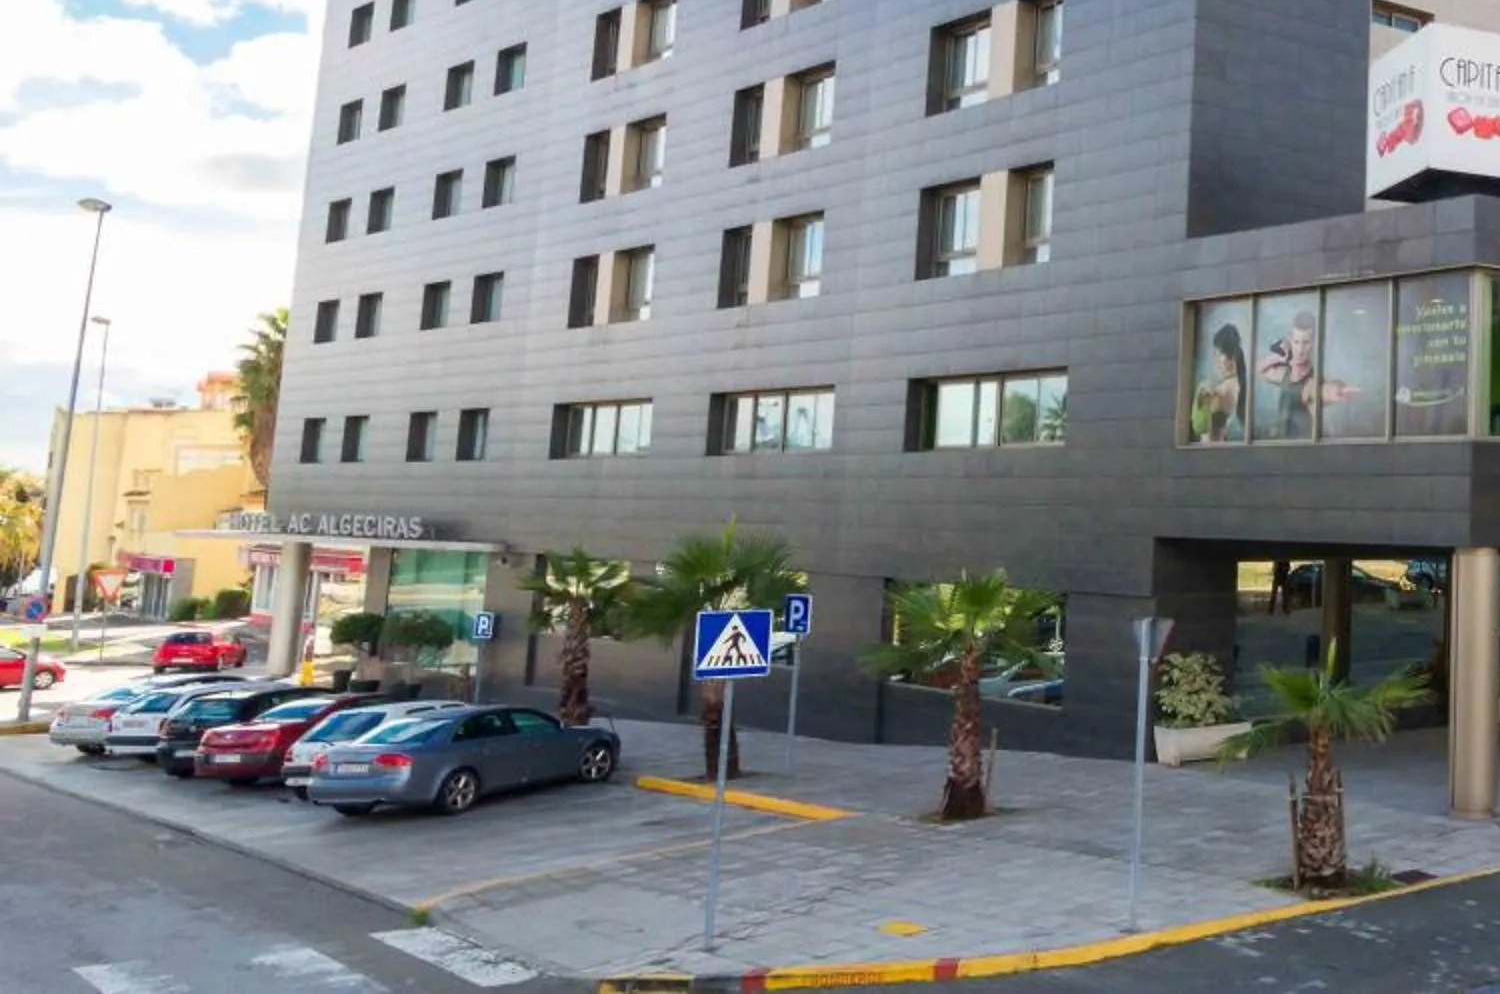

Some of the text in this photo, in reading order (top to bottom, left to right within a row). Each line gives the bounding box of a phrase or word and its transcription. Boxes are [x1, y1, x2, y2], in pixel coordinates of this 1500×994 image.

[287, 512, 312, 533] AC
[317, 513, 424, 539] ALGECIRAS
[477, 615, 489, 635] P
[788, 599, 805, 630] P
